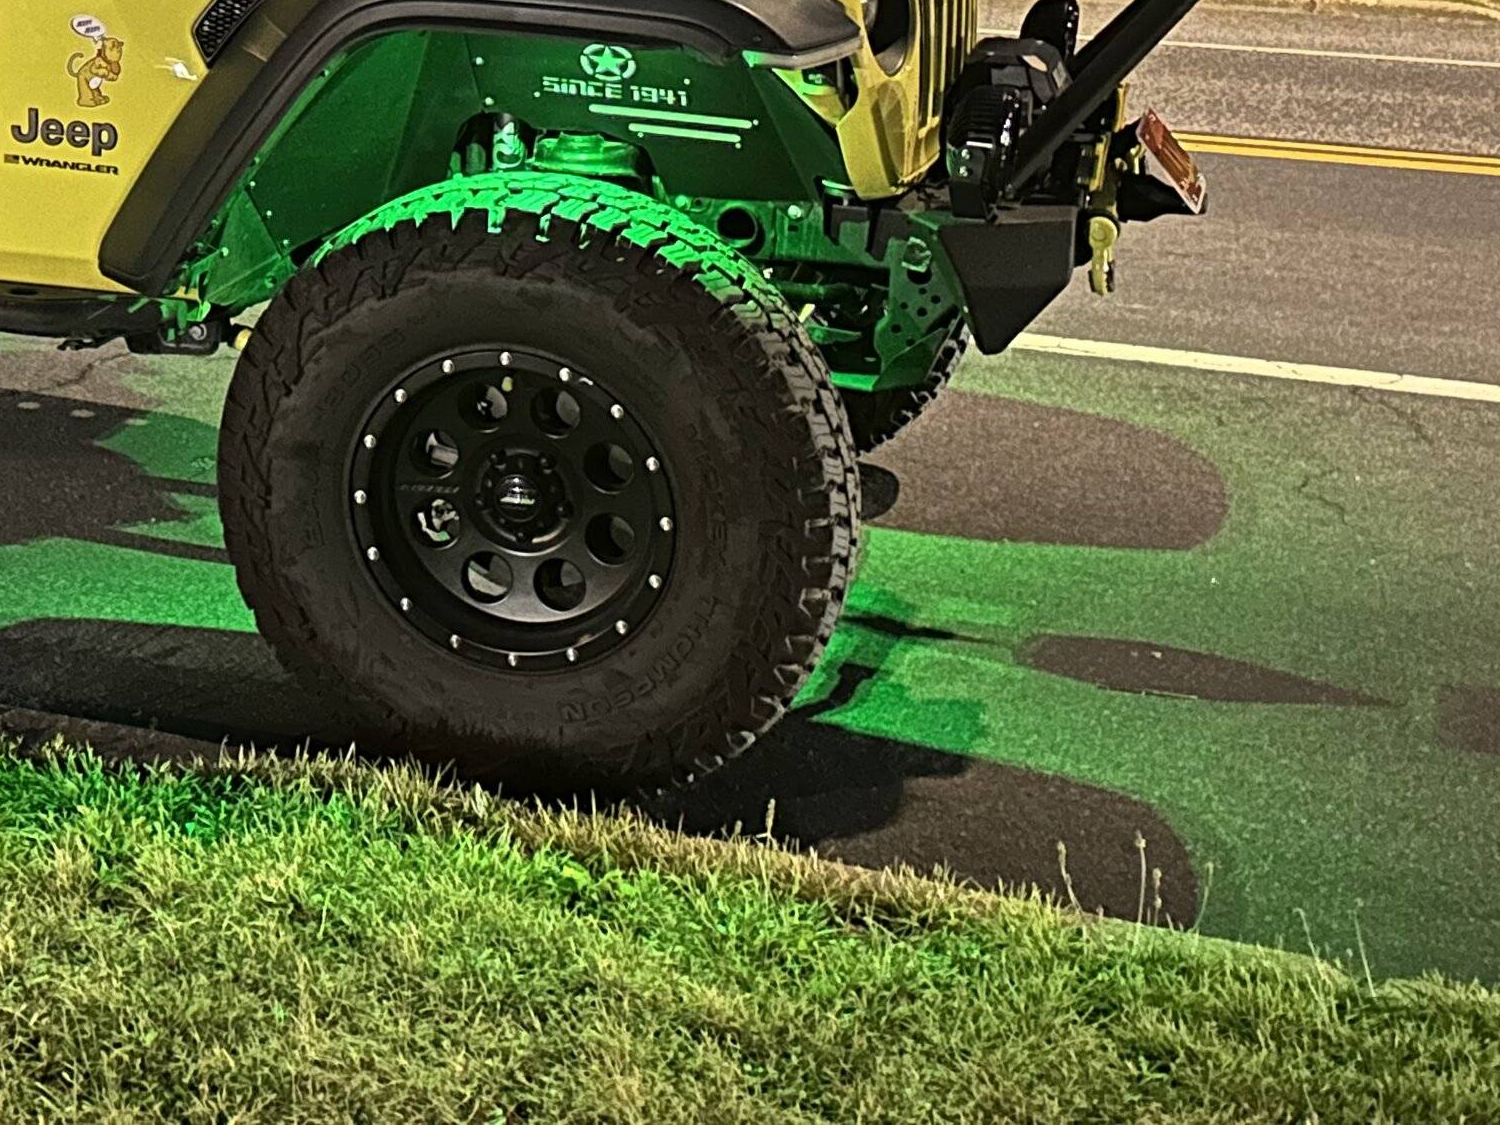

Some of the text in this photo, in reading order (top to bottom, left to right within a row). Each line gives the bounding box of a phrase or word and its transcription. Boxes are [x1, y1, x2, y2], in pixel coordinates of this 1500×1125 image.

[630, 85, 687, 107] 1941
[11, 107, 118, 157] Jeep
[21, 155, 120, 176] WRANGLER
